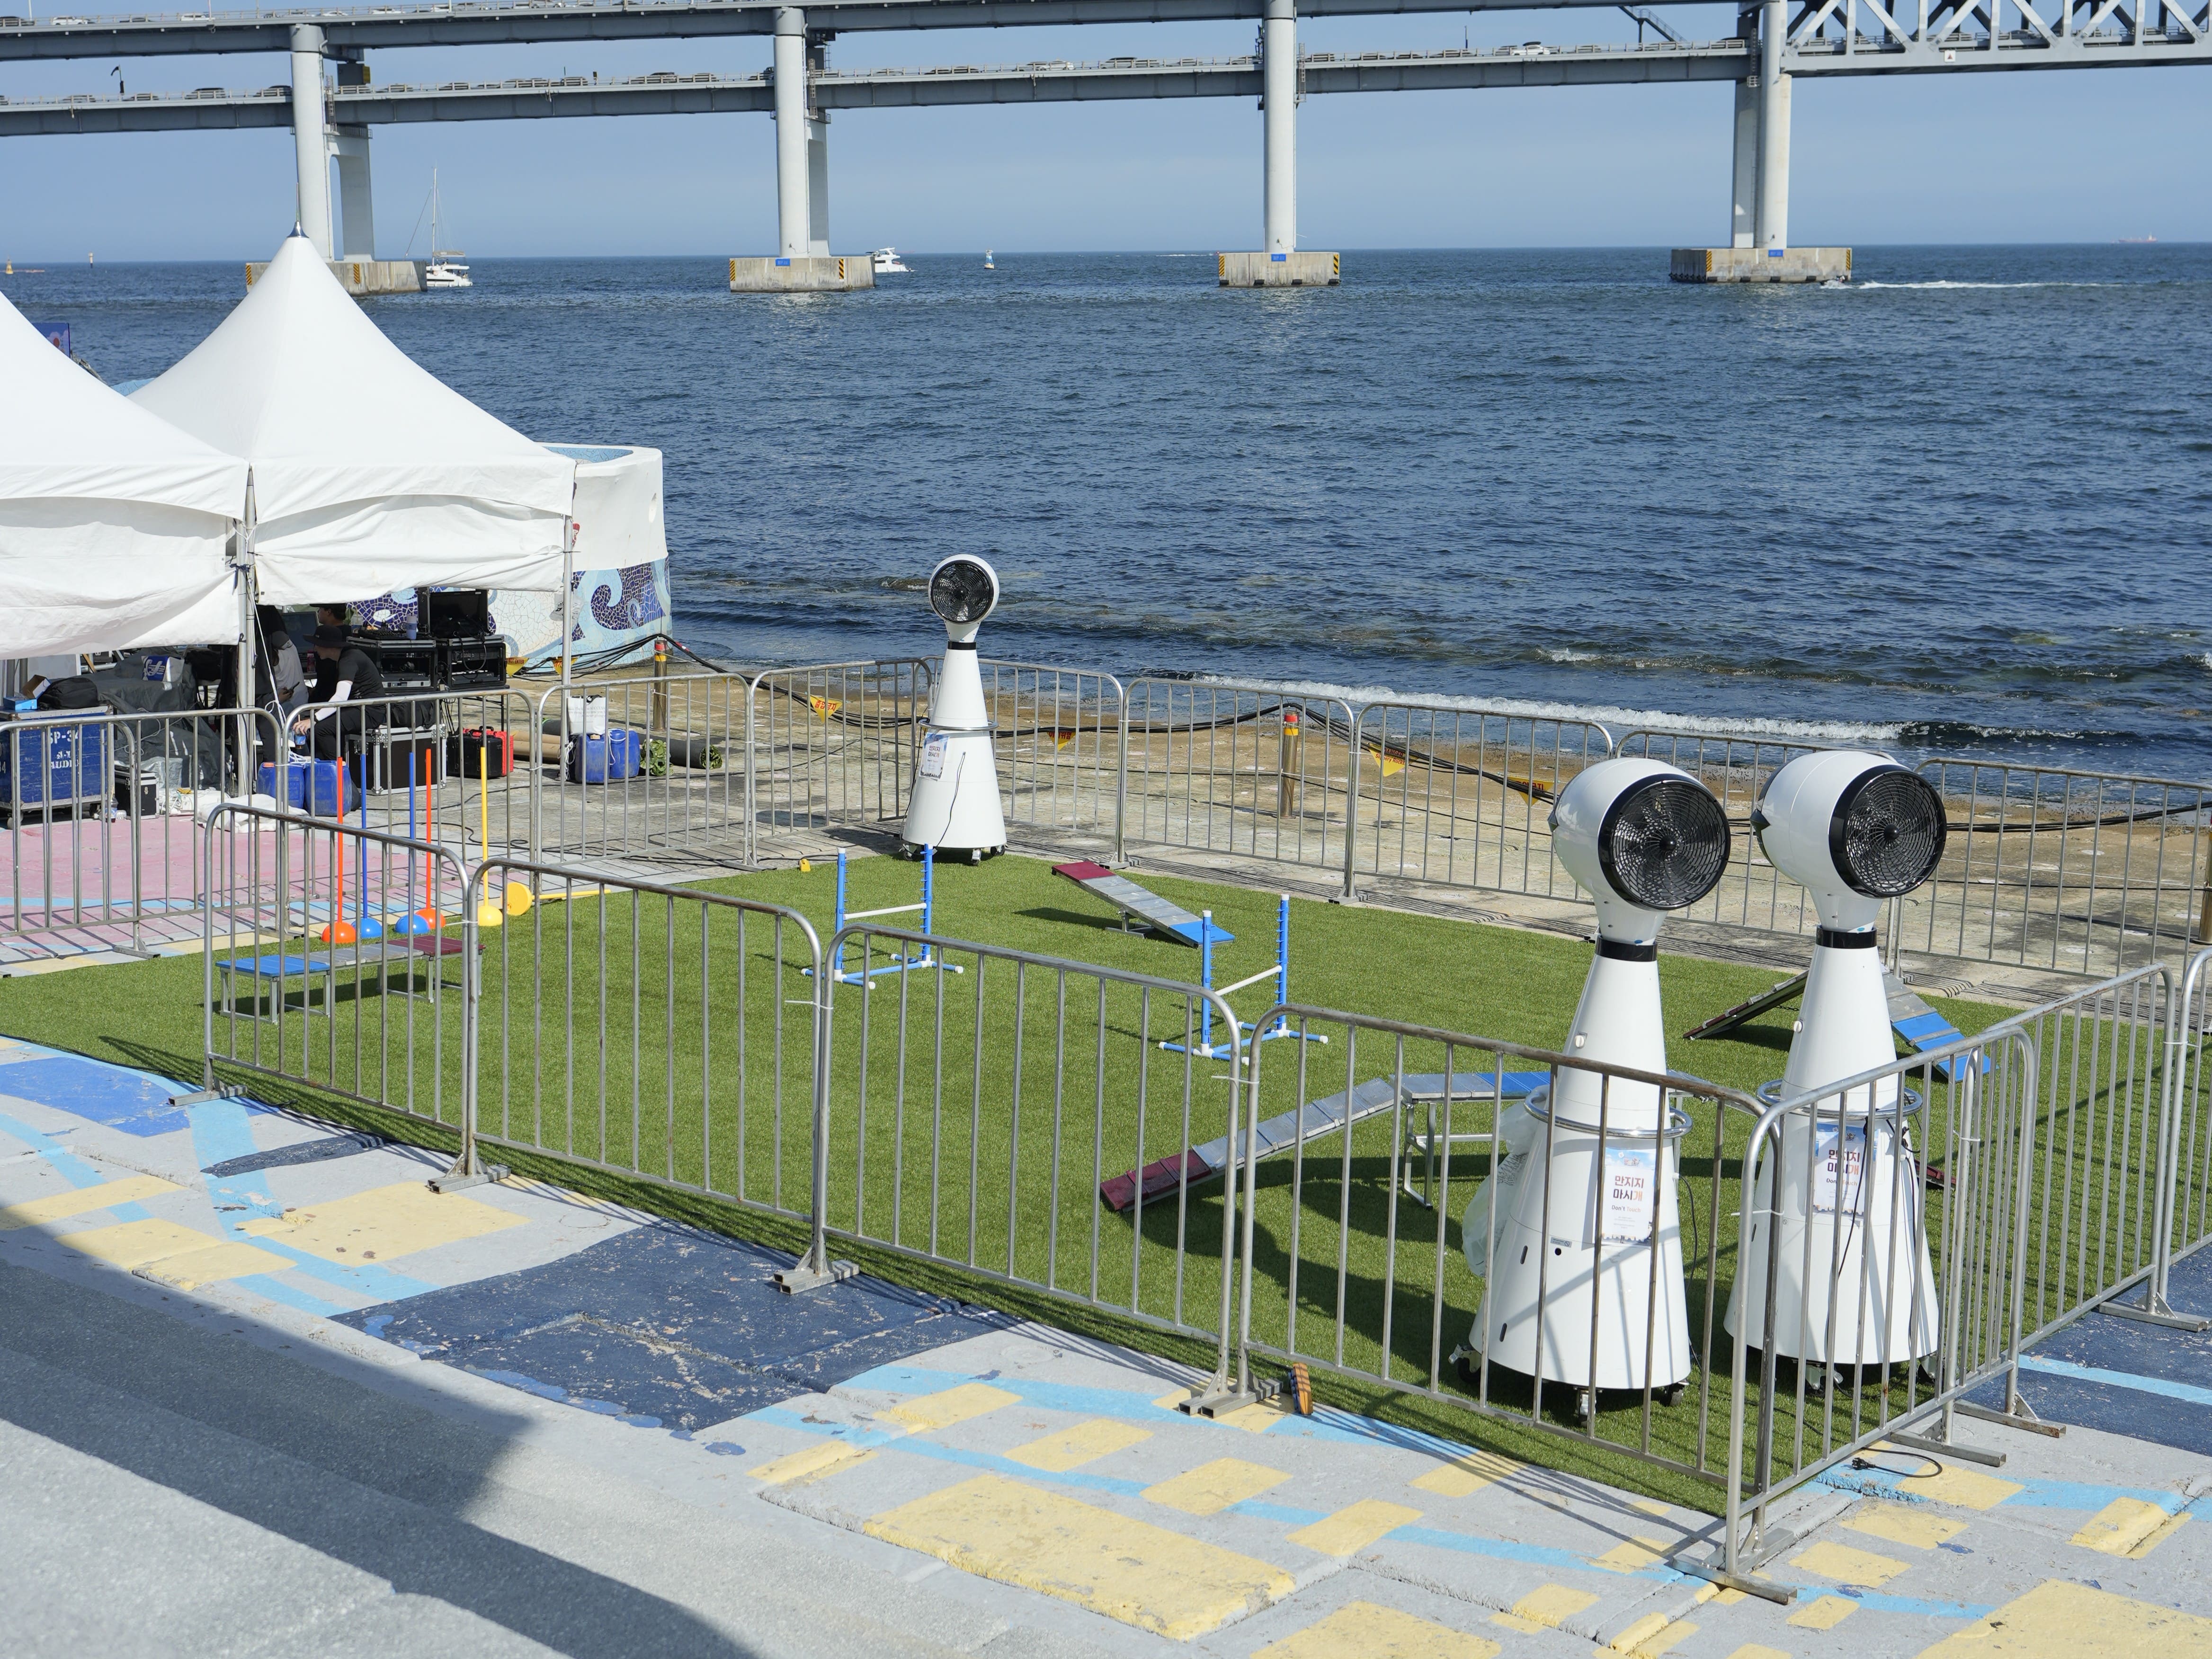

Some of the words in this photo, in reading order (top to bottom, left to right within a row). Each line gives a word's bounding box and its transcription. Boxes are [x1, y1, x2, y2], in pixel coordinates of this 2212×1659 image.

[1049, 731, 1072, 740] 이위험
[1375, 753, 1392, 763] Slipery
[50, 759, 79, 769] AUDI
[1614, 1175, 1644, 1188] 만지지
[1613, 1188, 1643, 1202] 마시개
